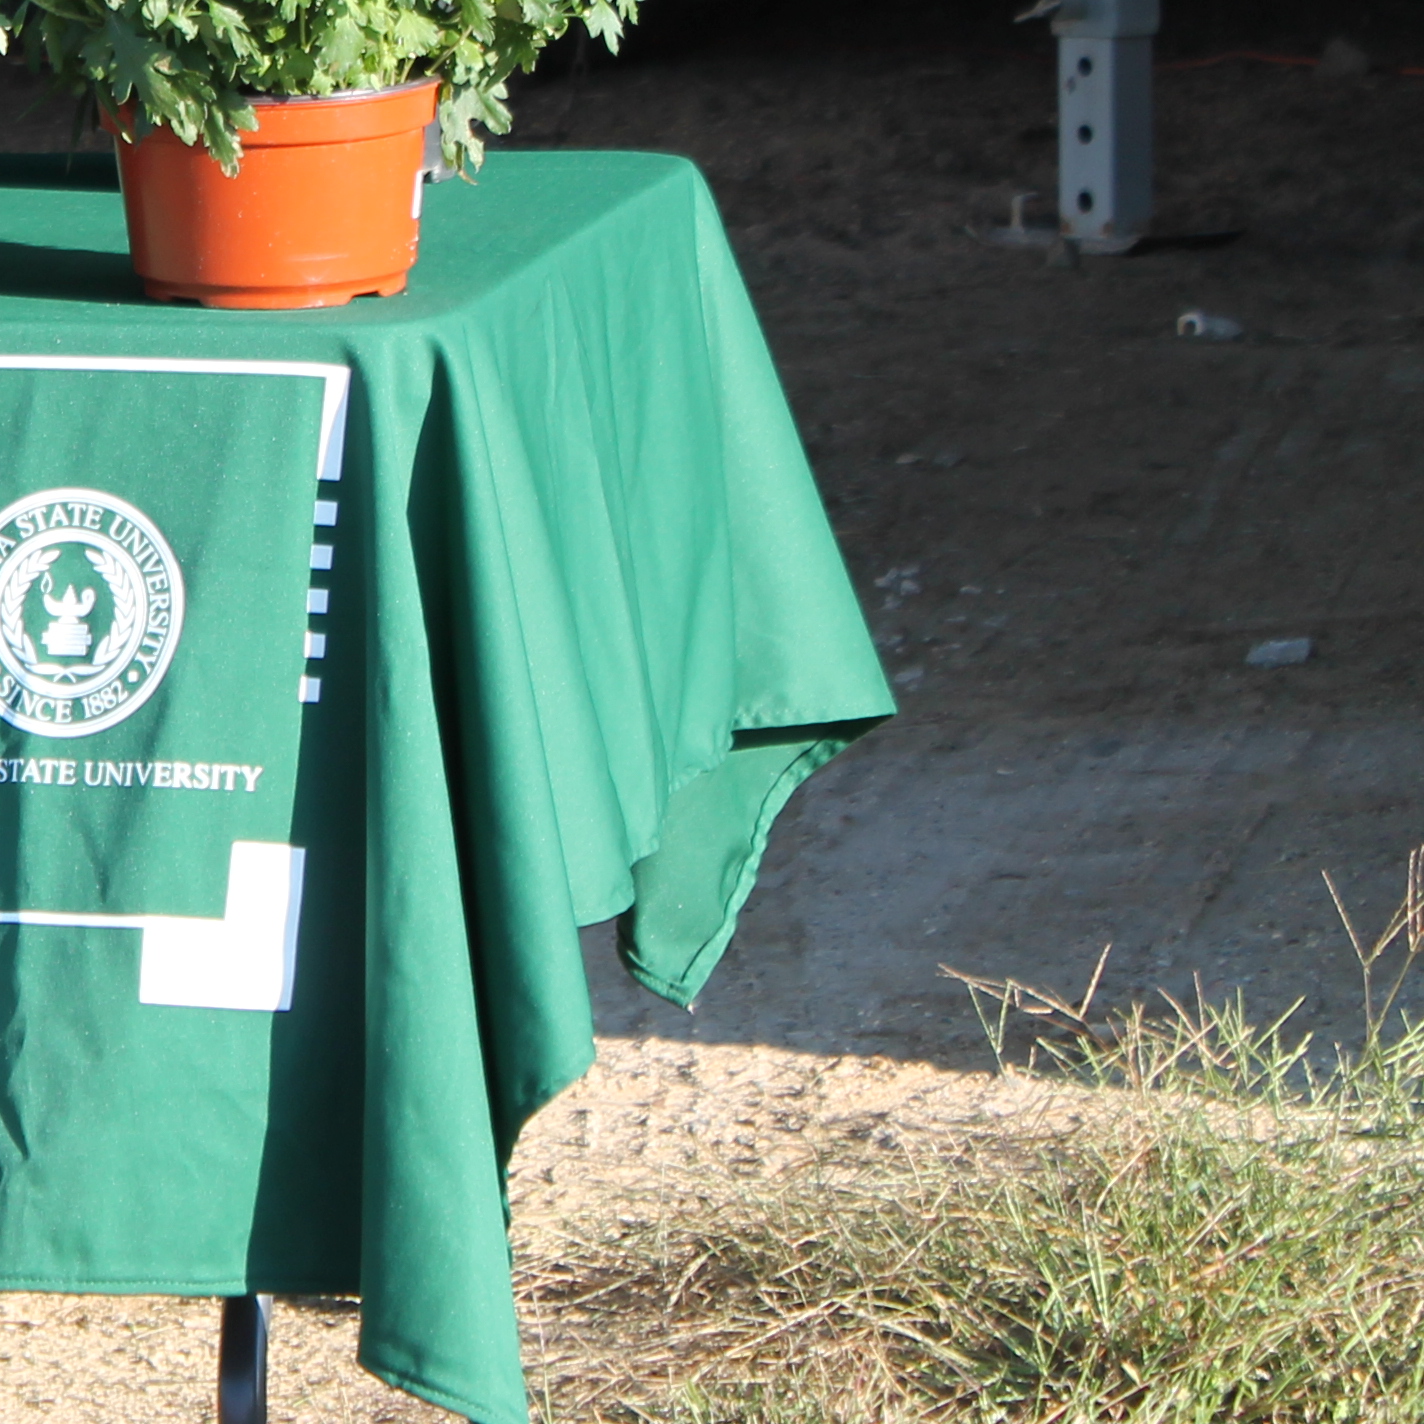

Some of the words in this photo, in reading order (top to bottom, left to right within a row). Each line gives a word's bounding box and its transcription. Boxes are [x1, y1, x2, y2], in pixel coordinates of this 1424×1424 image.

[15, 502, 105, 539] STATE
[108, 513, 171, 675] UNIVERSITY
[81, 679, 130, 719] 1882
[84, 759, 264, 793] UNIVERSITY
